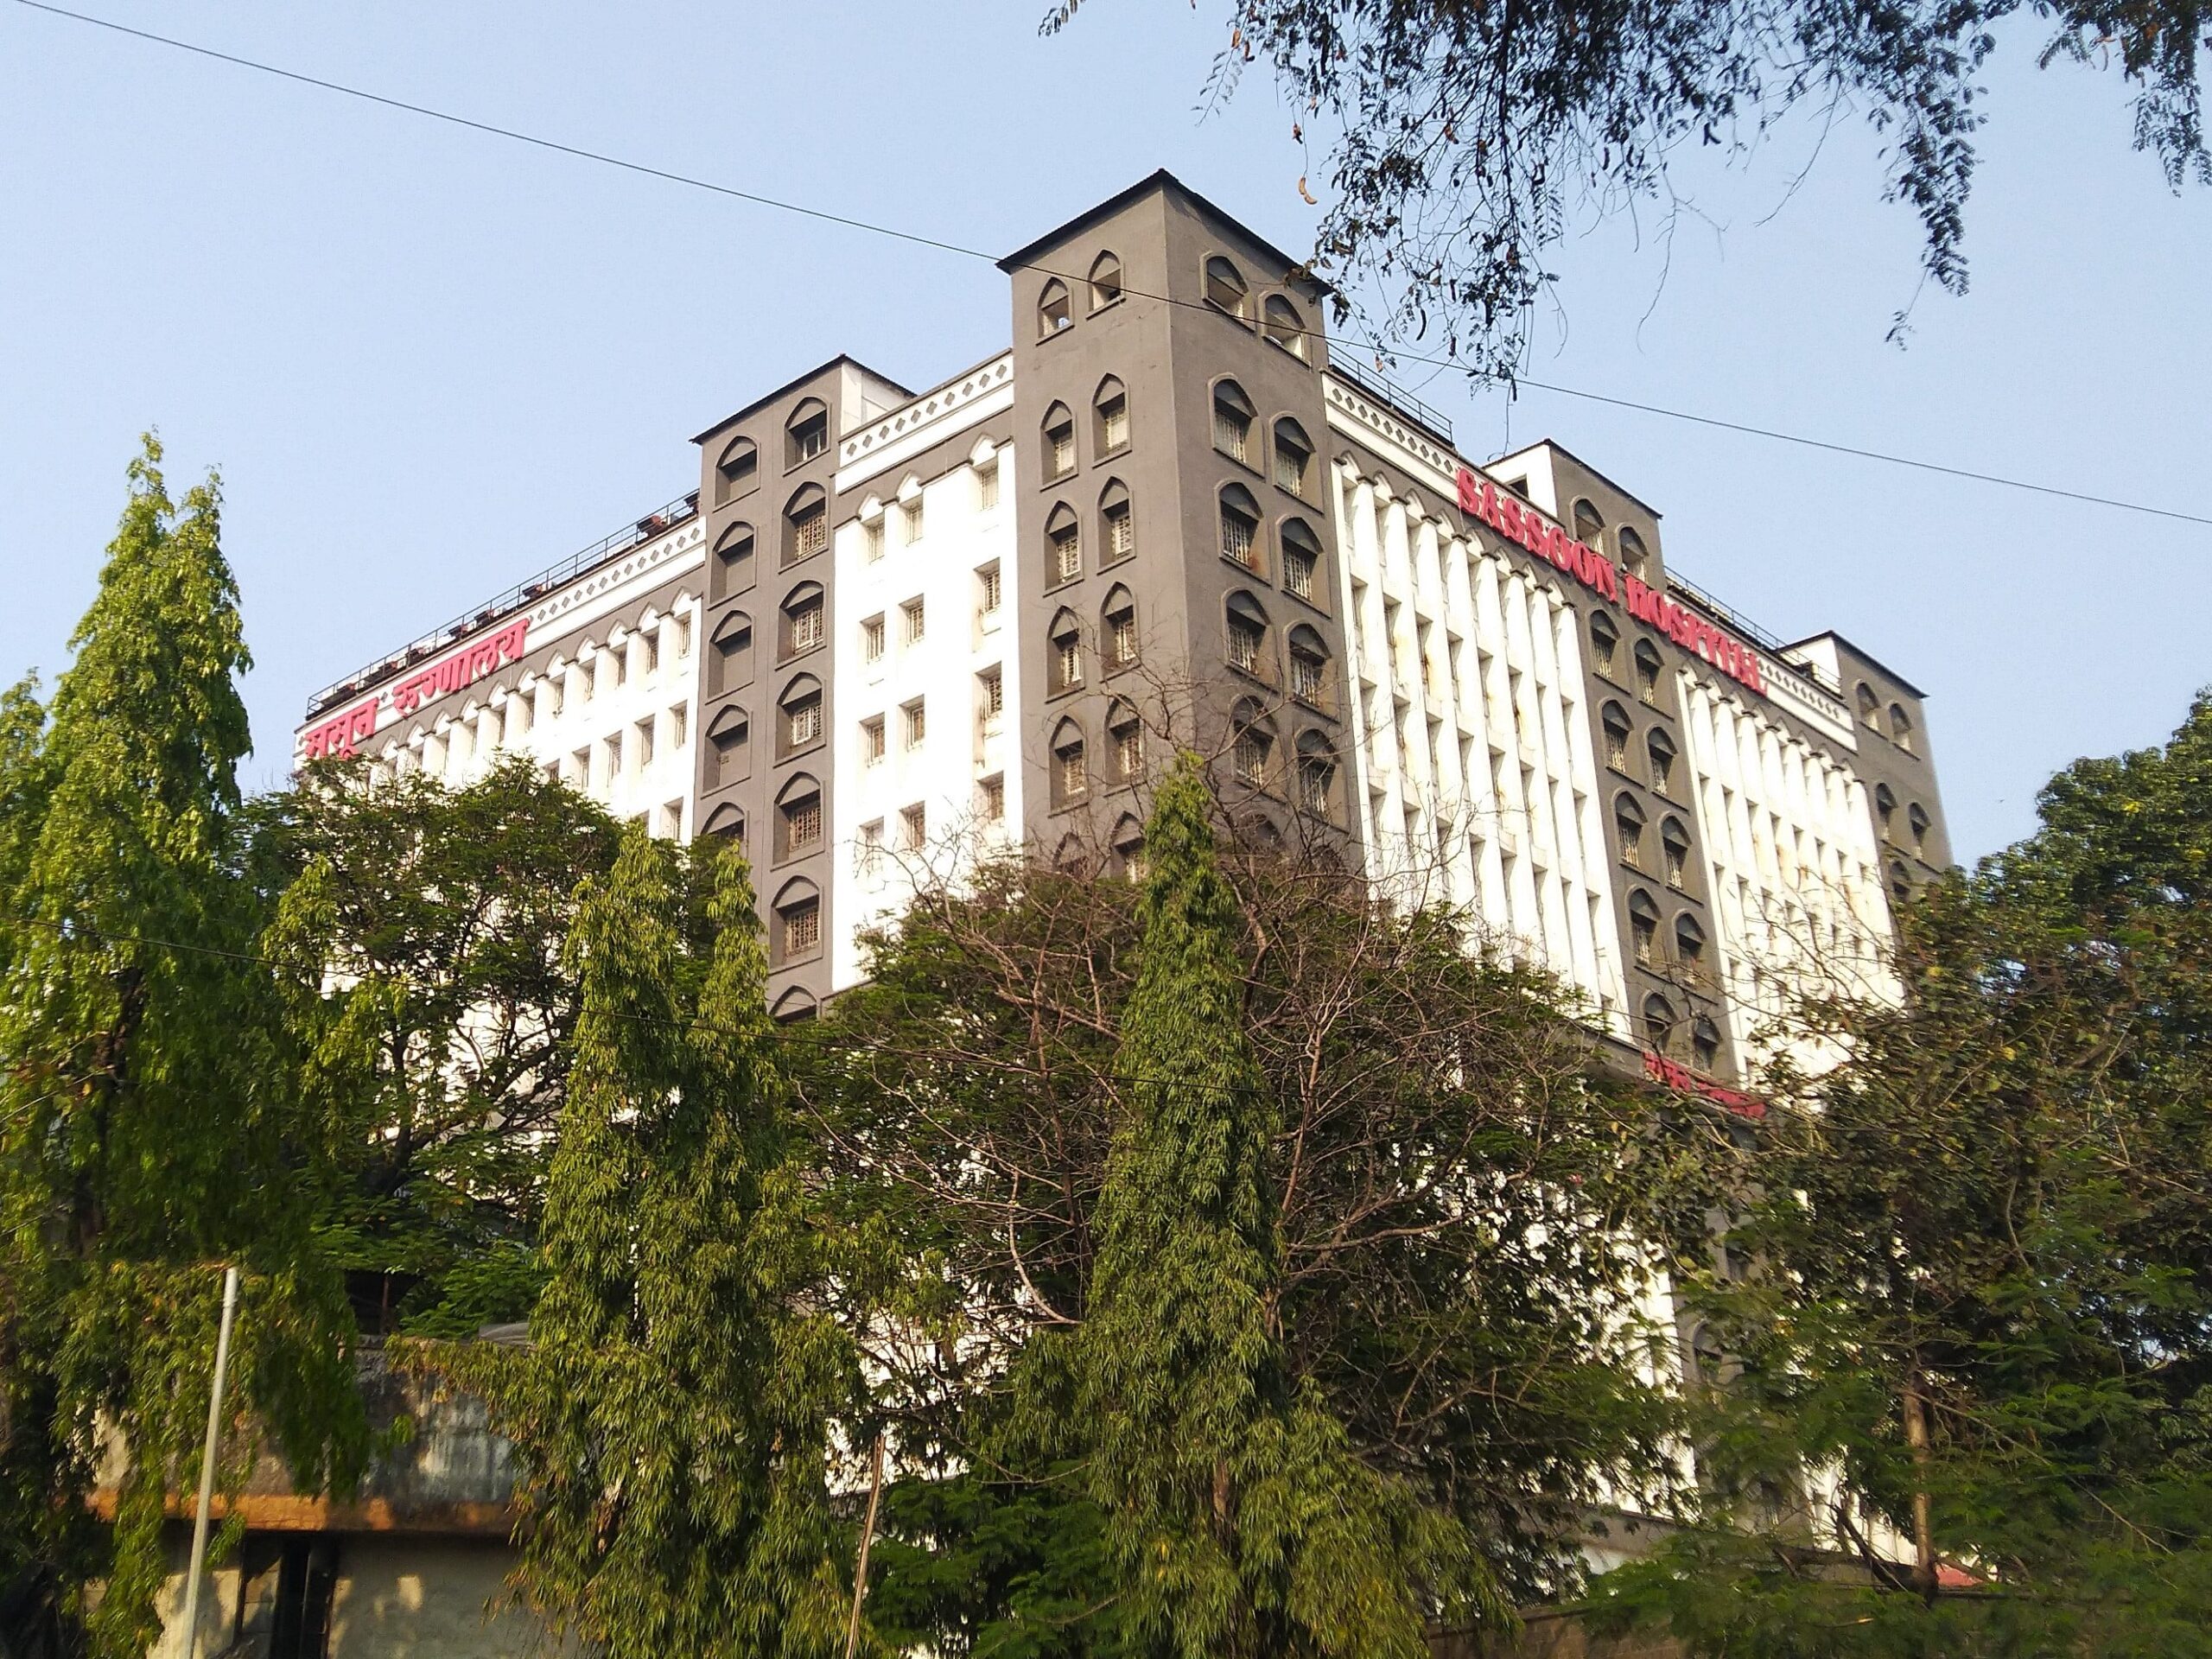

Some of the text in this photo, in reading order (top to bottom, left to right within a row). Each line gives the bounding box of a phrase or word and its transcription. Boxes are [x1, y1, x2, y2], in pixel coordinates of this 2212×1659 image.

[1455, 467, 1768, 697] SASSOON HOSPITAL
[304, 697, 378, 760] ससून
